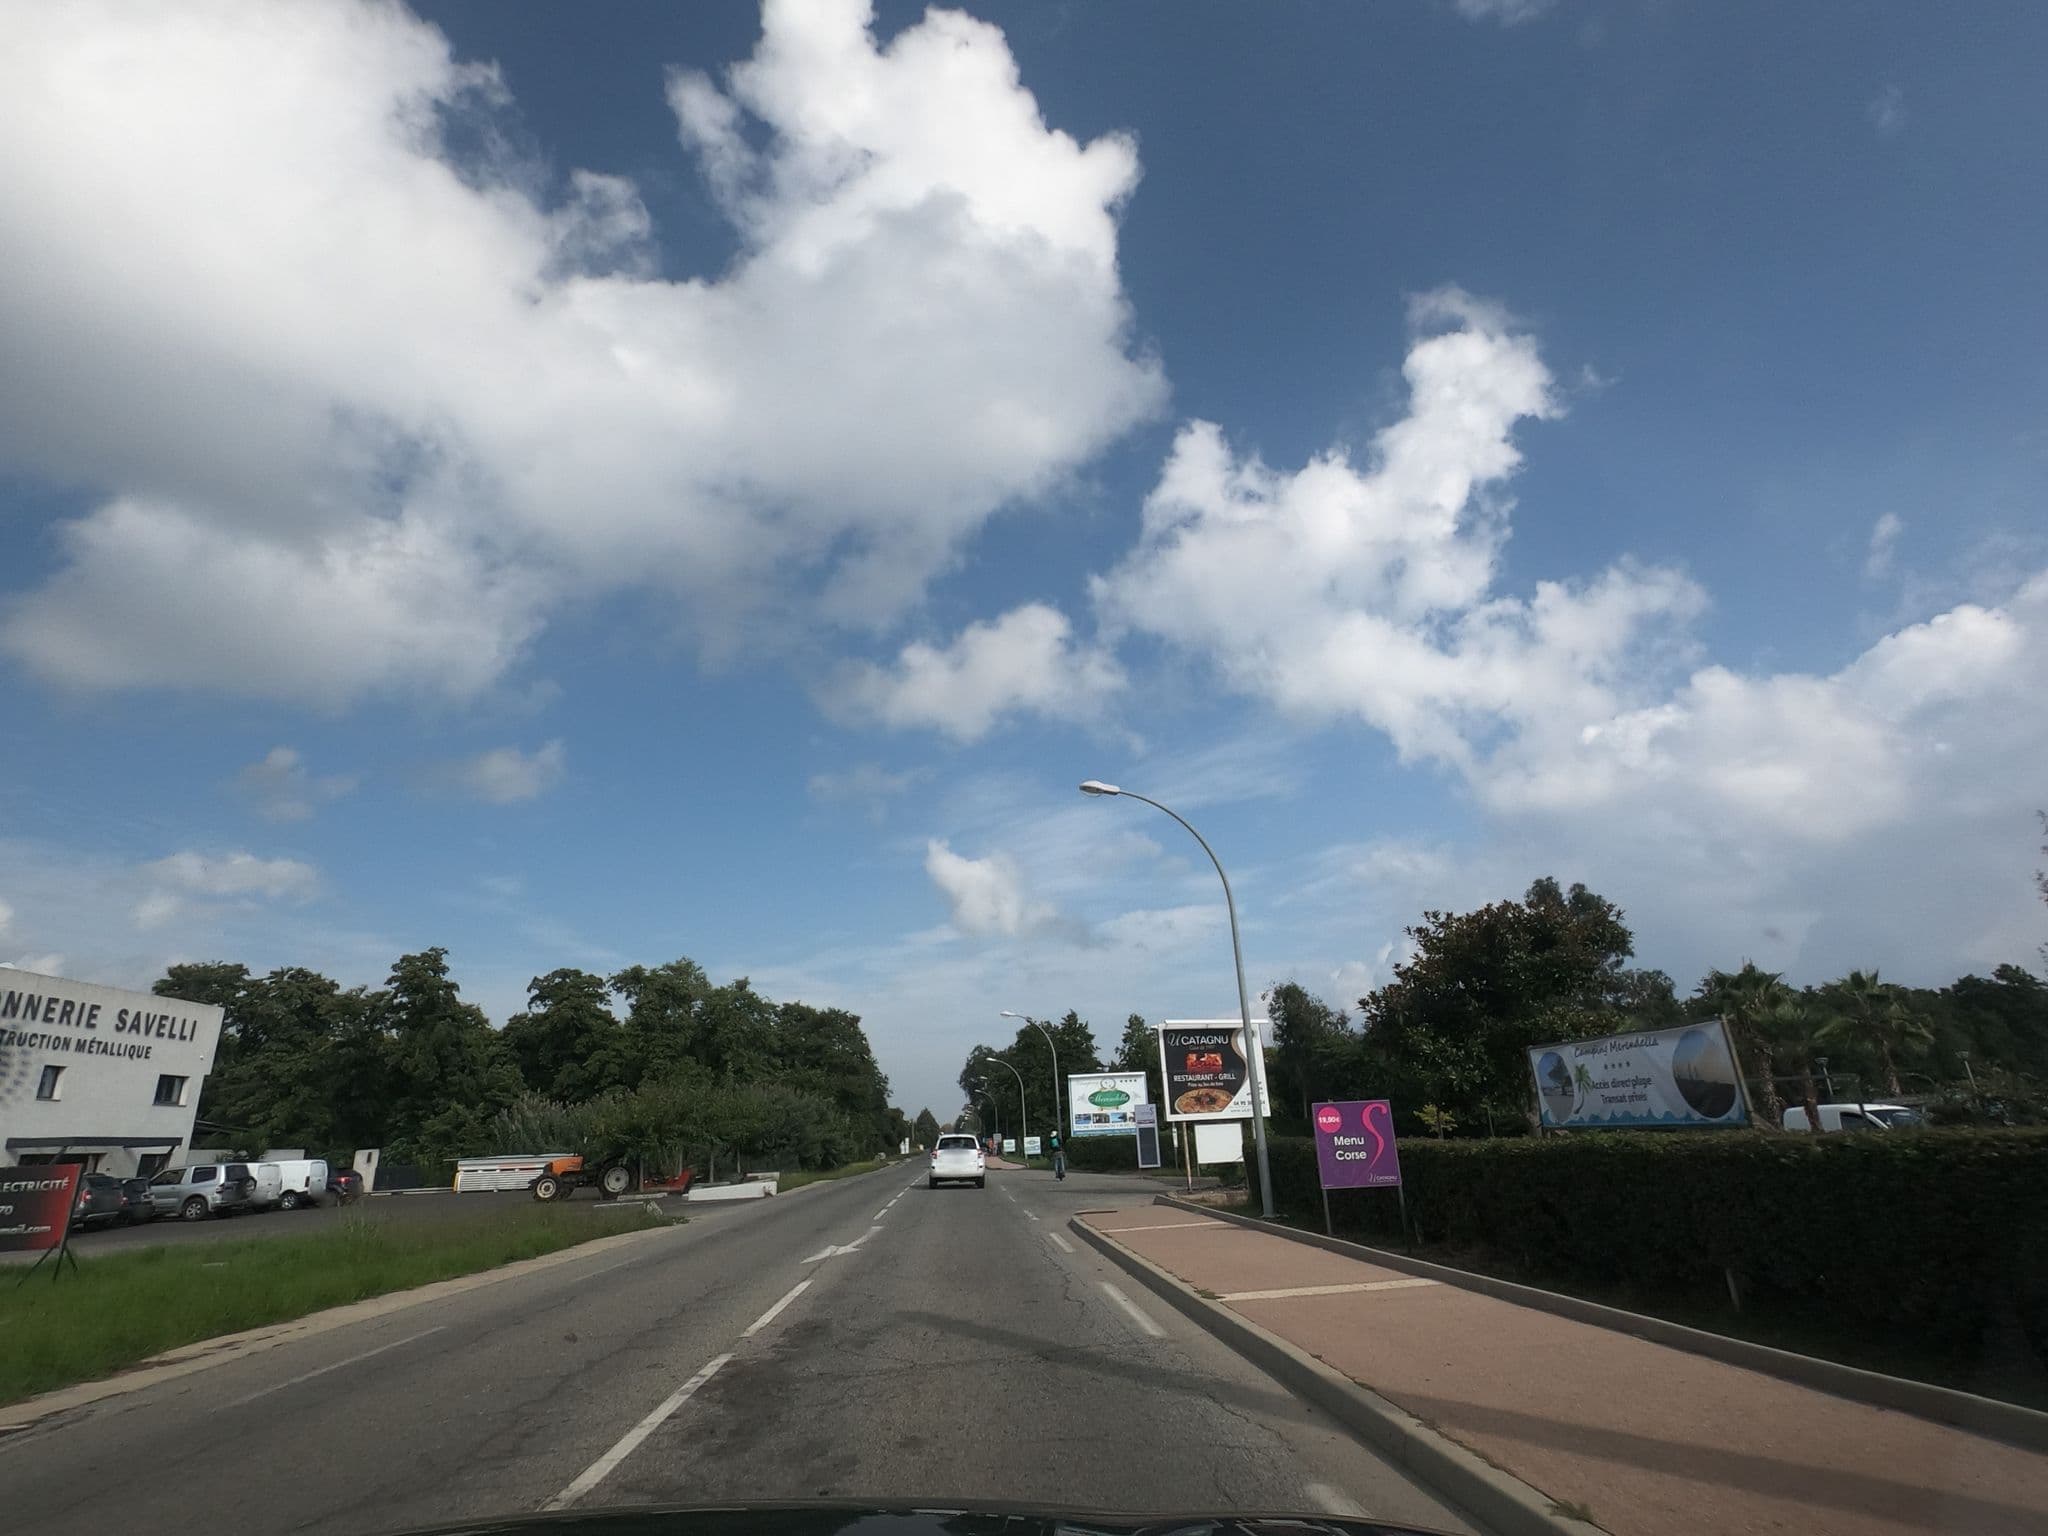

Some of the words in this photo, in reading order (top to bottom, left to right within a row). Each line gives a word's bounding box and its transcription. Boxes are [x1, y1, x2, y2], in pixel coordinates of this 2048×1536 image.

[115, 1008, 197, 1042] SAVELLI
[1181, 1035, 1229, 1045] CATAGNU
[75, 1037, 152, 1060] MÉTALLIQUE
[1173, 1073, 1214, 1082] RESTAURANT
[1218, 1073, 1236, 1081] GRILL
[1631, 1075, 1653, 1089] plage
[1334, 1136, 1365, 1146] Menu
[1335, 1151, 1367, 1161] Corse
